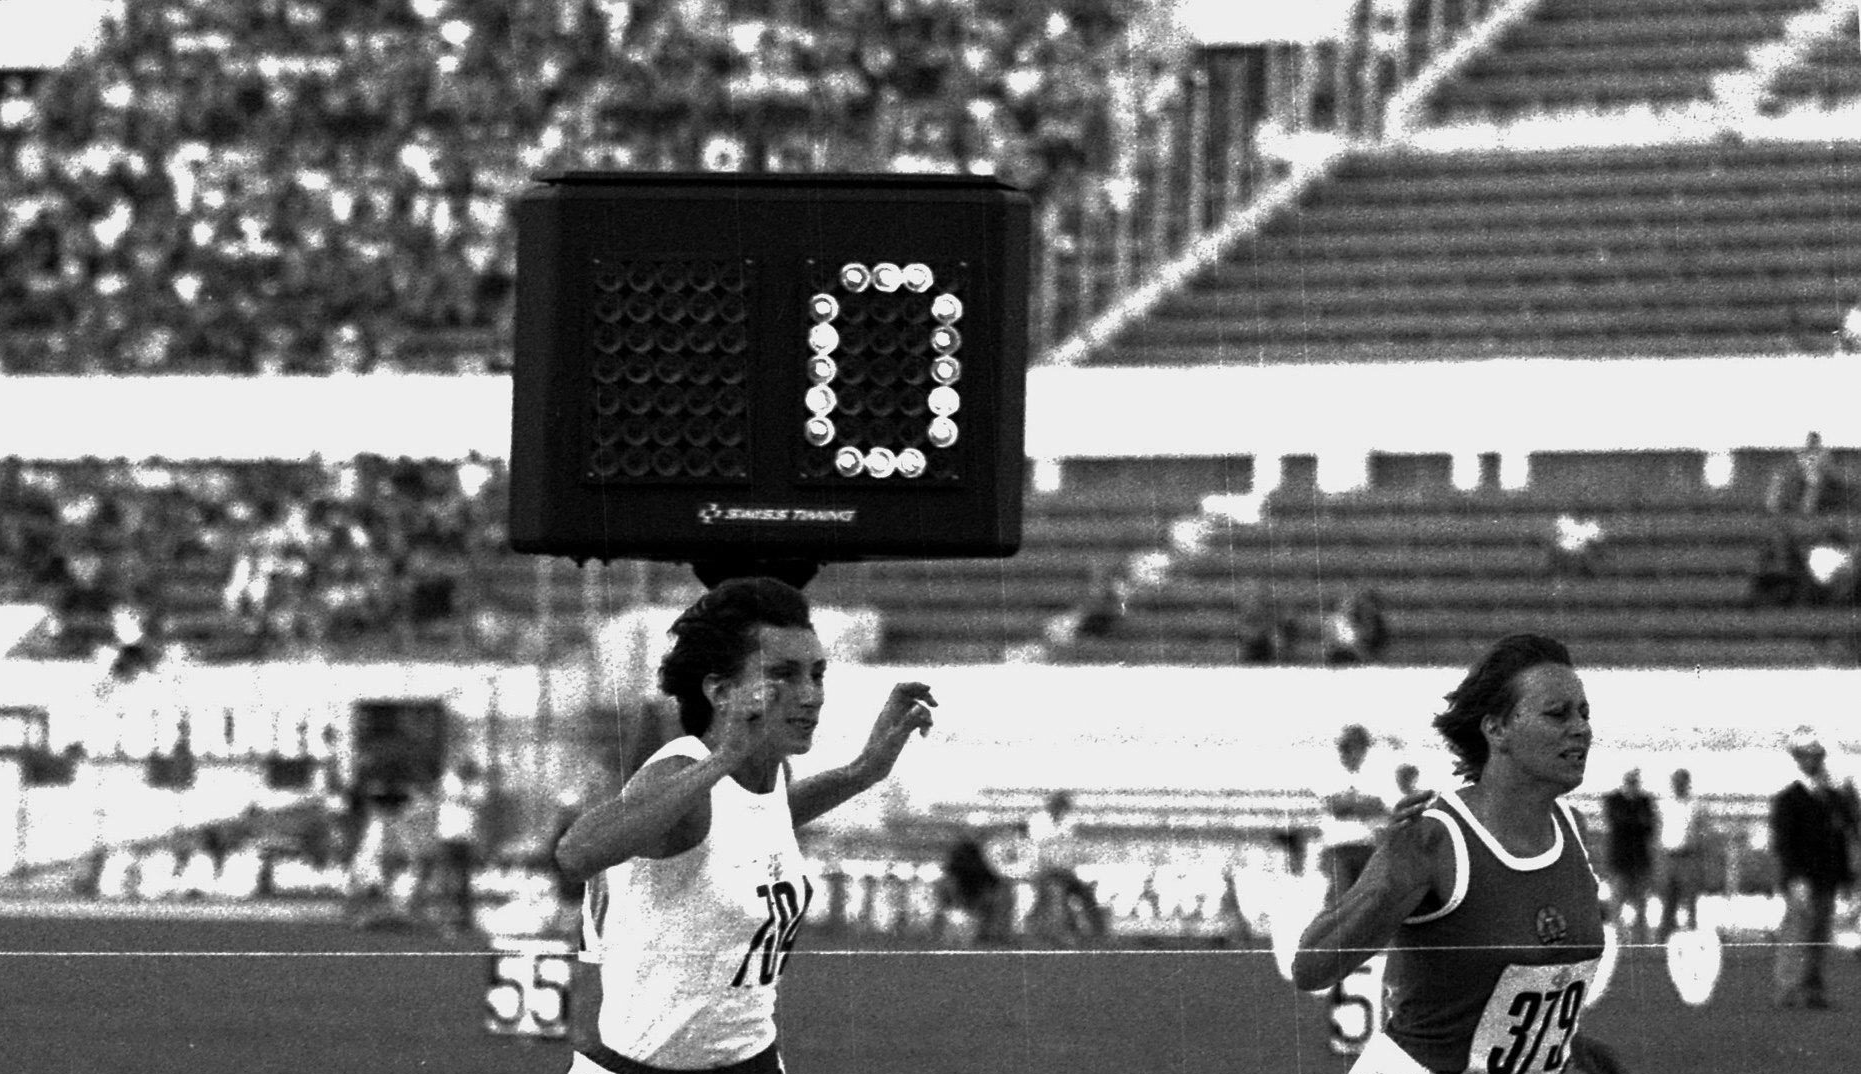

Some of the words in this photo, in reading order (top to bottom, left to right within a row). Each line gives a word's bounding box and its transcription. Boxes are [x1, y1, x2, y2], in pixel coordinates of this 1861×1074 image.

[806, 262, 962, 478] 0
[724, 508, 789, 520] SWISS
[791, 509, 856, 522] TIMING
[486, 953, 570, 1025] 55
